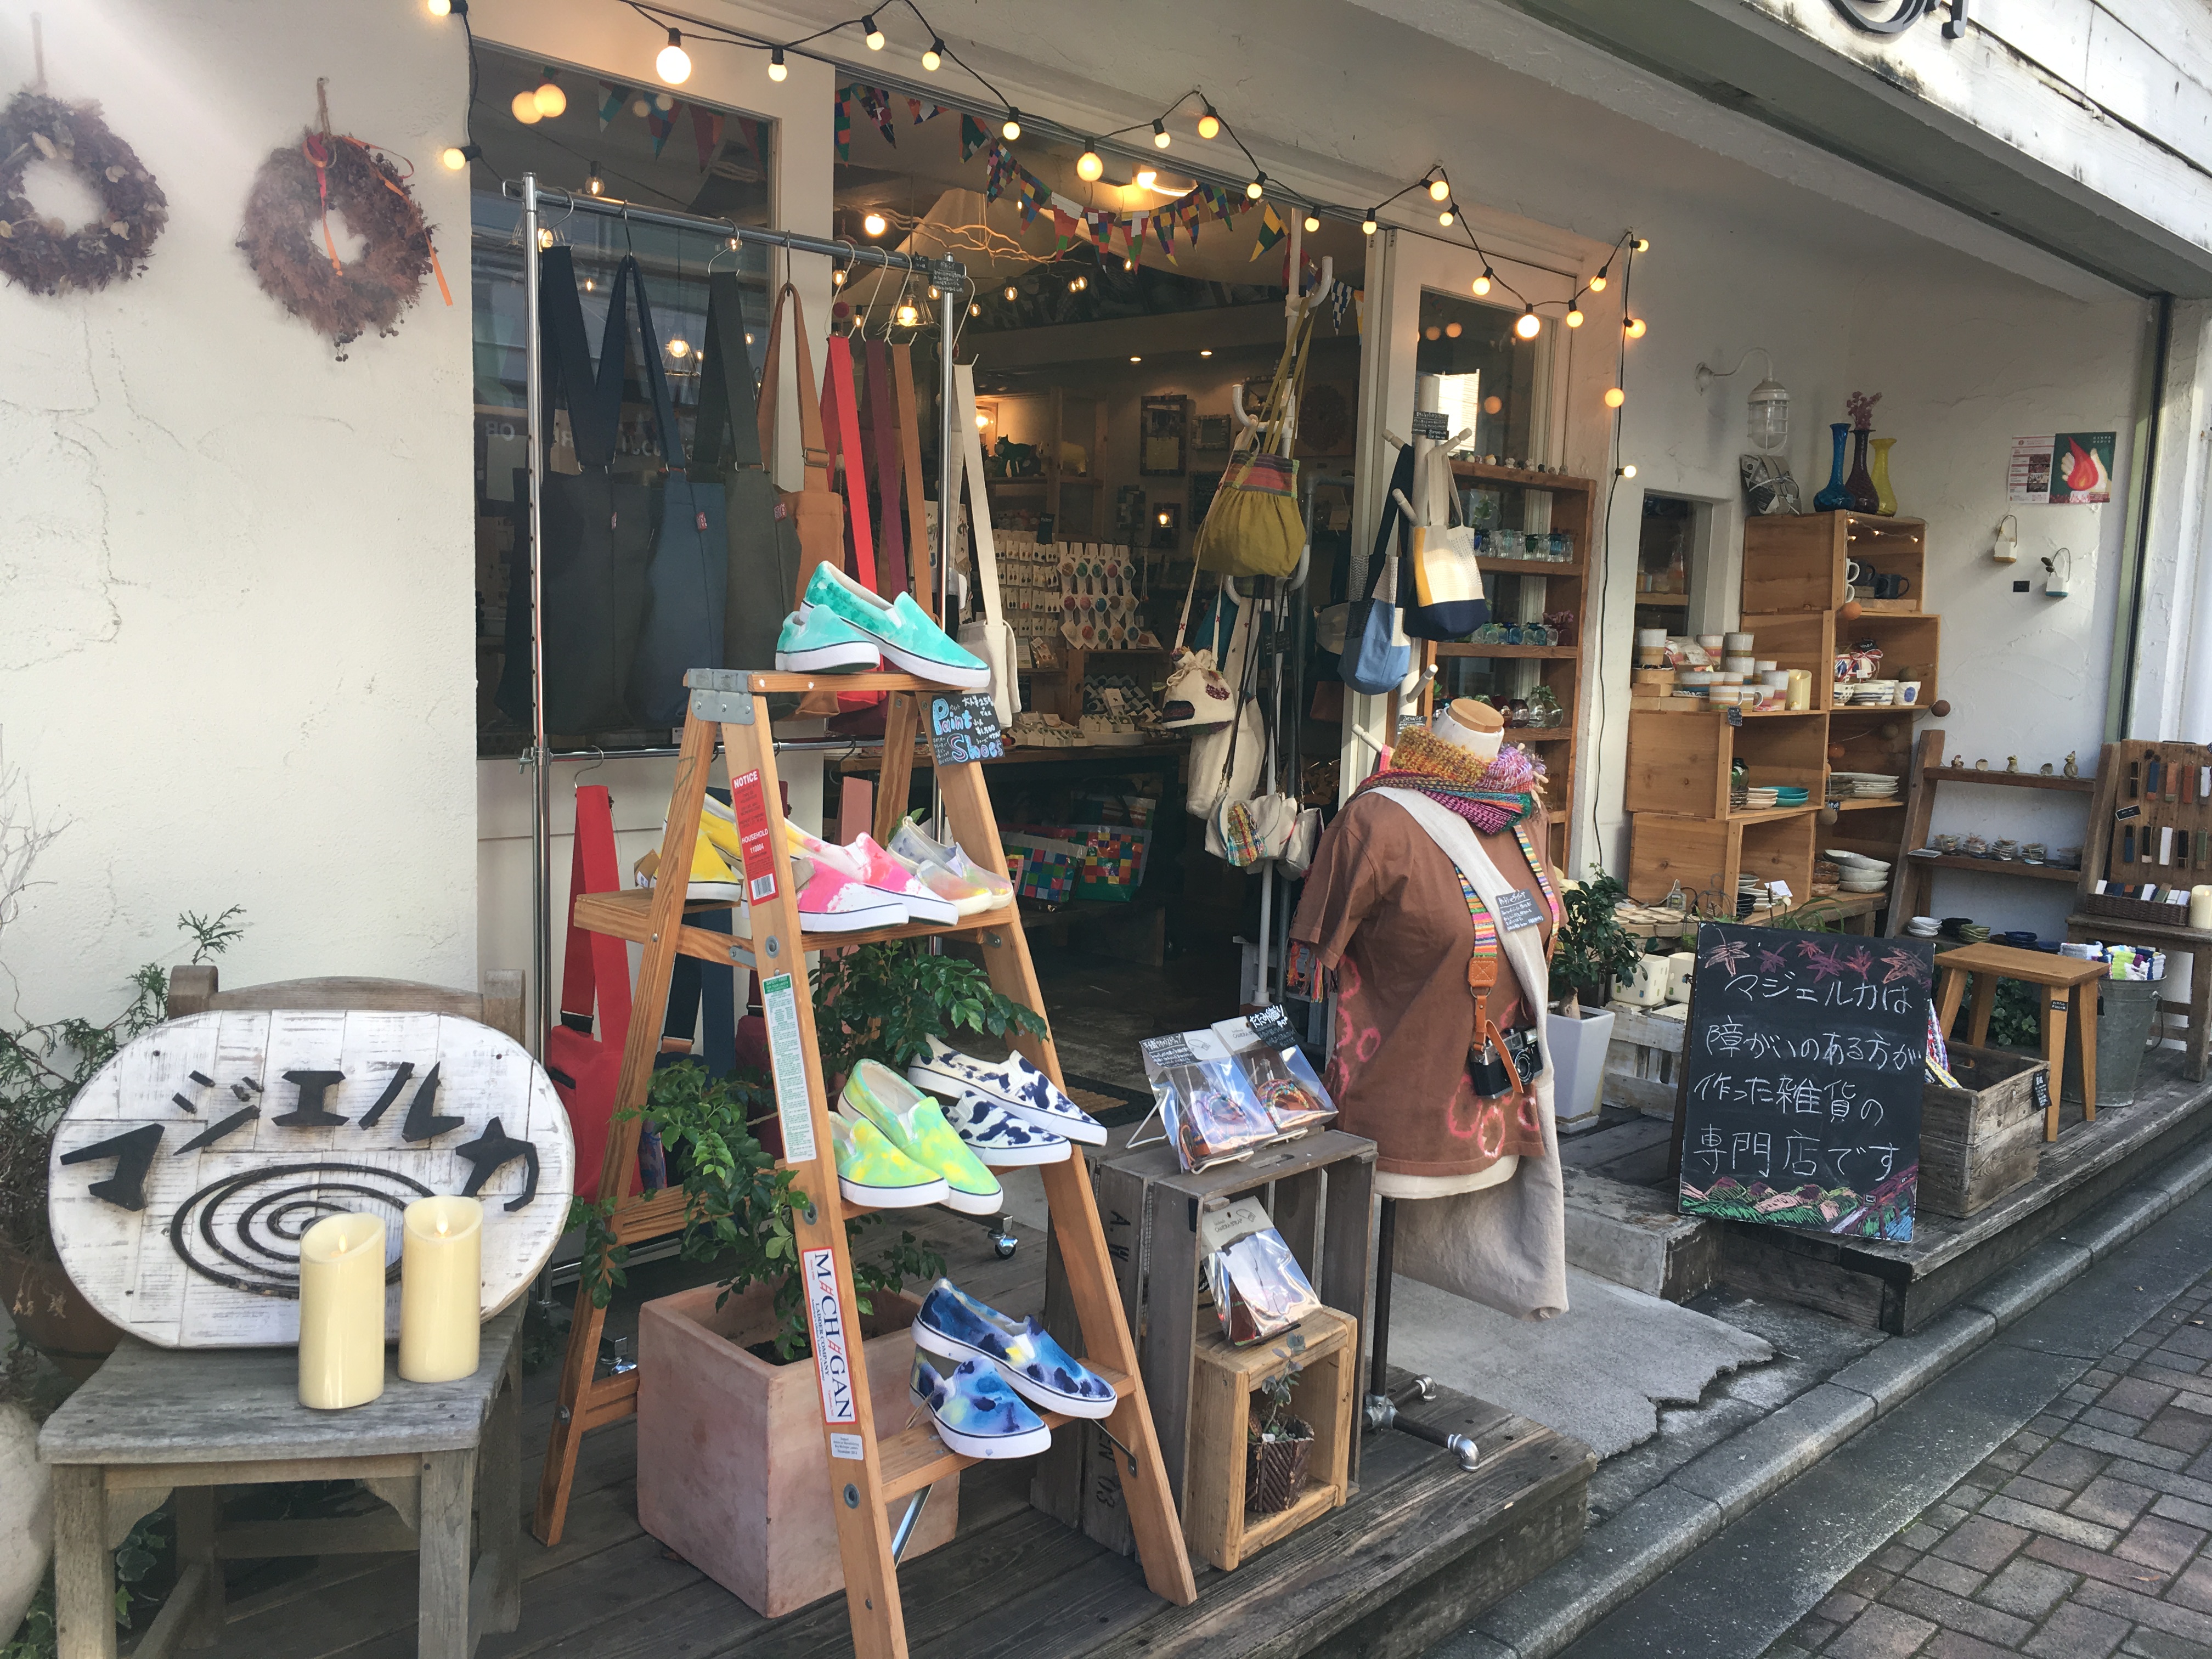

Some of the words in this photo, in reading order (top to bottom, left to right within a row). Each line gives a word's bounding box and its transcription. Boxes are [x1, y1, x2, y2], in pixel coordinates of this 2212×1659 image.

[932, 698, 973, 736] Paint
[947, 733, 1003, 763] Shoes
[733, 771, 758, 789] NOTICE
[741, 828, 769, 844] HOUSEHOLD
[1725, 970, 1913, 1014] マジェルカは
[1706, 1015, 1922, 1071] 障がいのある方が
[1694, 1072, 1884, 1126] 作った雑貨の
[1693, 1124, 1900, 1181] 専門店です
[815, 1303, 824, 1335] LADDER
[819, 1335, 830, 1376] COMPANY
